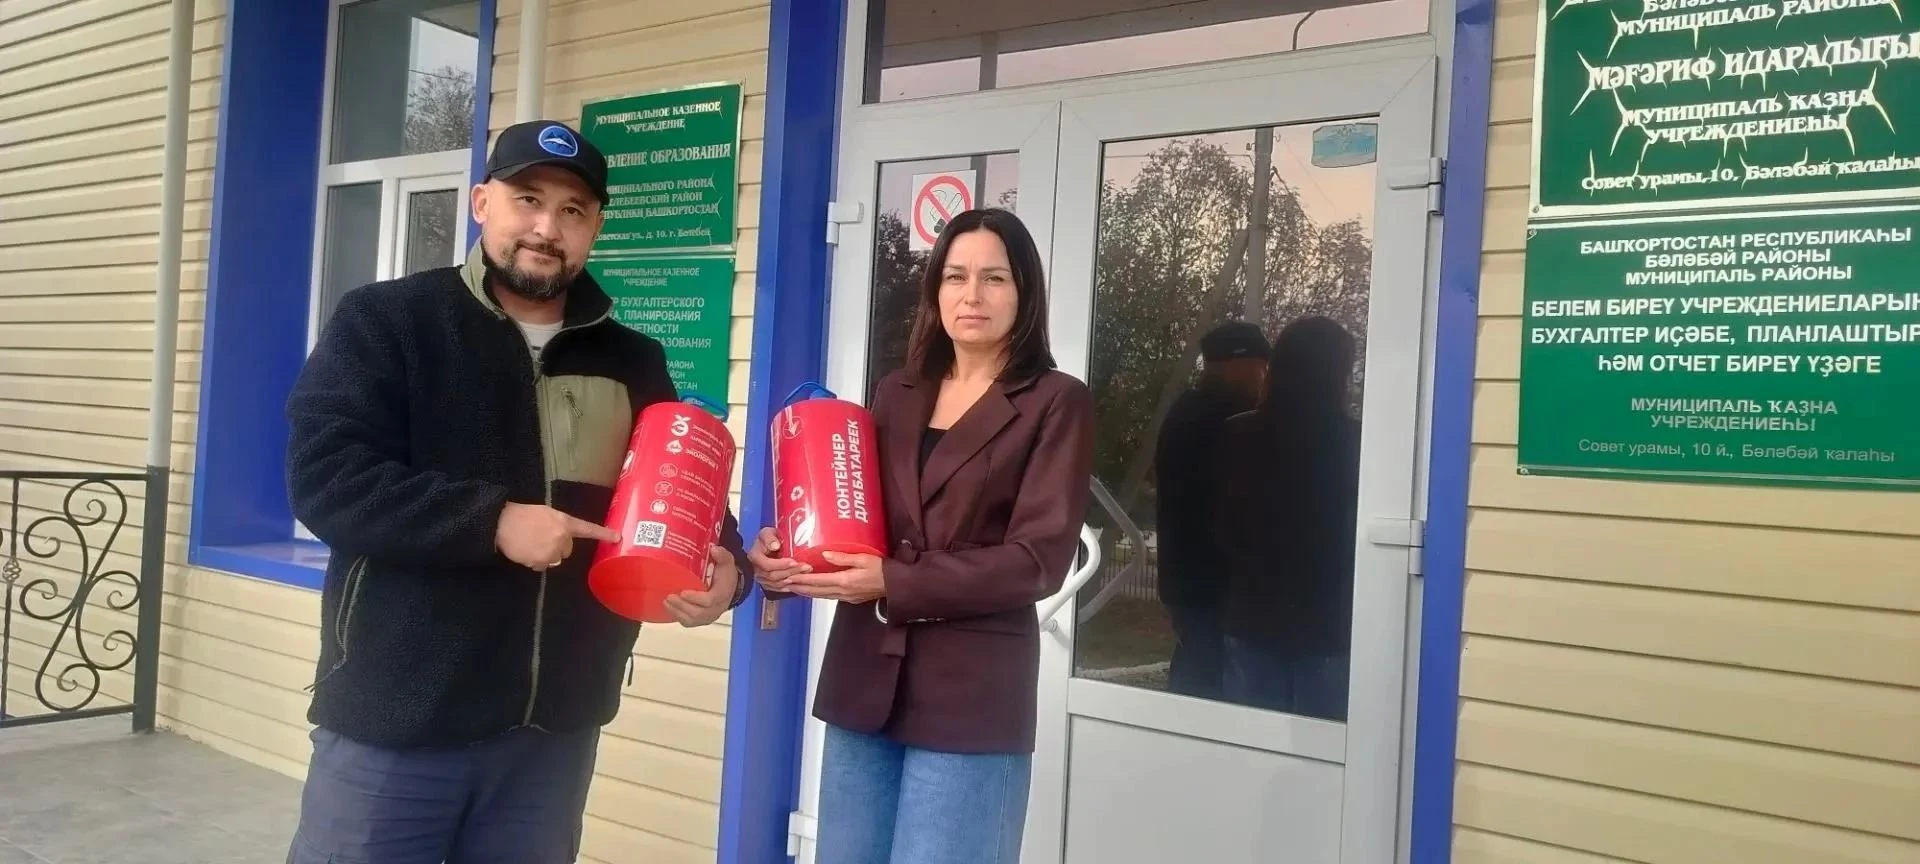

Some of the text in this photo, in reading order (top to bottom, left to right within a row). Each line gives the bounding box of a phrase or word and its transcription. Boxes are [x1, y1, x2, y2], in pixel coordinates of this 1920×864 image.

[1615, 4, 1776, 38] МУНИЦИПАЛЬ
[673, 101, 720, 115] КАЗЕННОЕ
[1622, 97, 1783, 127] МУНИЦИПАЛЬ
[626, 118, 685, 134] УЧРЕЖДЕНИЕ
[604, 143, 731, 168] ВЛЕНИЕ ОБРАЗОВАНИЯ
[1581, 174, 1634, 190] Совет
[1741, 247, 1832, 265] РАЙОНЫ
[1626, 264, 1852, 286] МУНИЦИПАЛЬ РАЙОНЫ
[621, 296, 705, 308] БУХГАЛТЕРСКОГО
[1531, 300, 1601, 317] БЕЛЕМ
[624, 309, 701, 321] ПЛАНИРОВАНИЯ
[1531, 327, 1649, 344] БУХГАЛТЕР
[1747, 324, 1920, 343] ПЛАНЛАШТЫР
[1649, 354, 1721, 372] ОТЧЕТ
[1631, 397, 1763, 414] МУНИЦИПАЛЬ
[1578, 438, 1625, 453] Совет
[1628, 443, 1686, 458] урамы,
[1693, 443, 1711, 456] 10
[832, 433, 850, 520] КОНТЕЙНЕР
[847, 418, 869, 524] ДЛЯ БАТАРЕЕК
